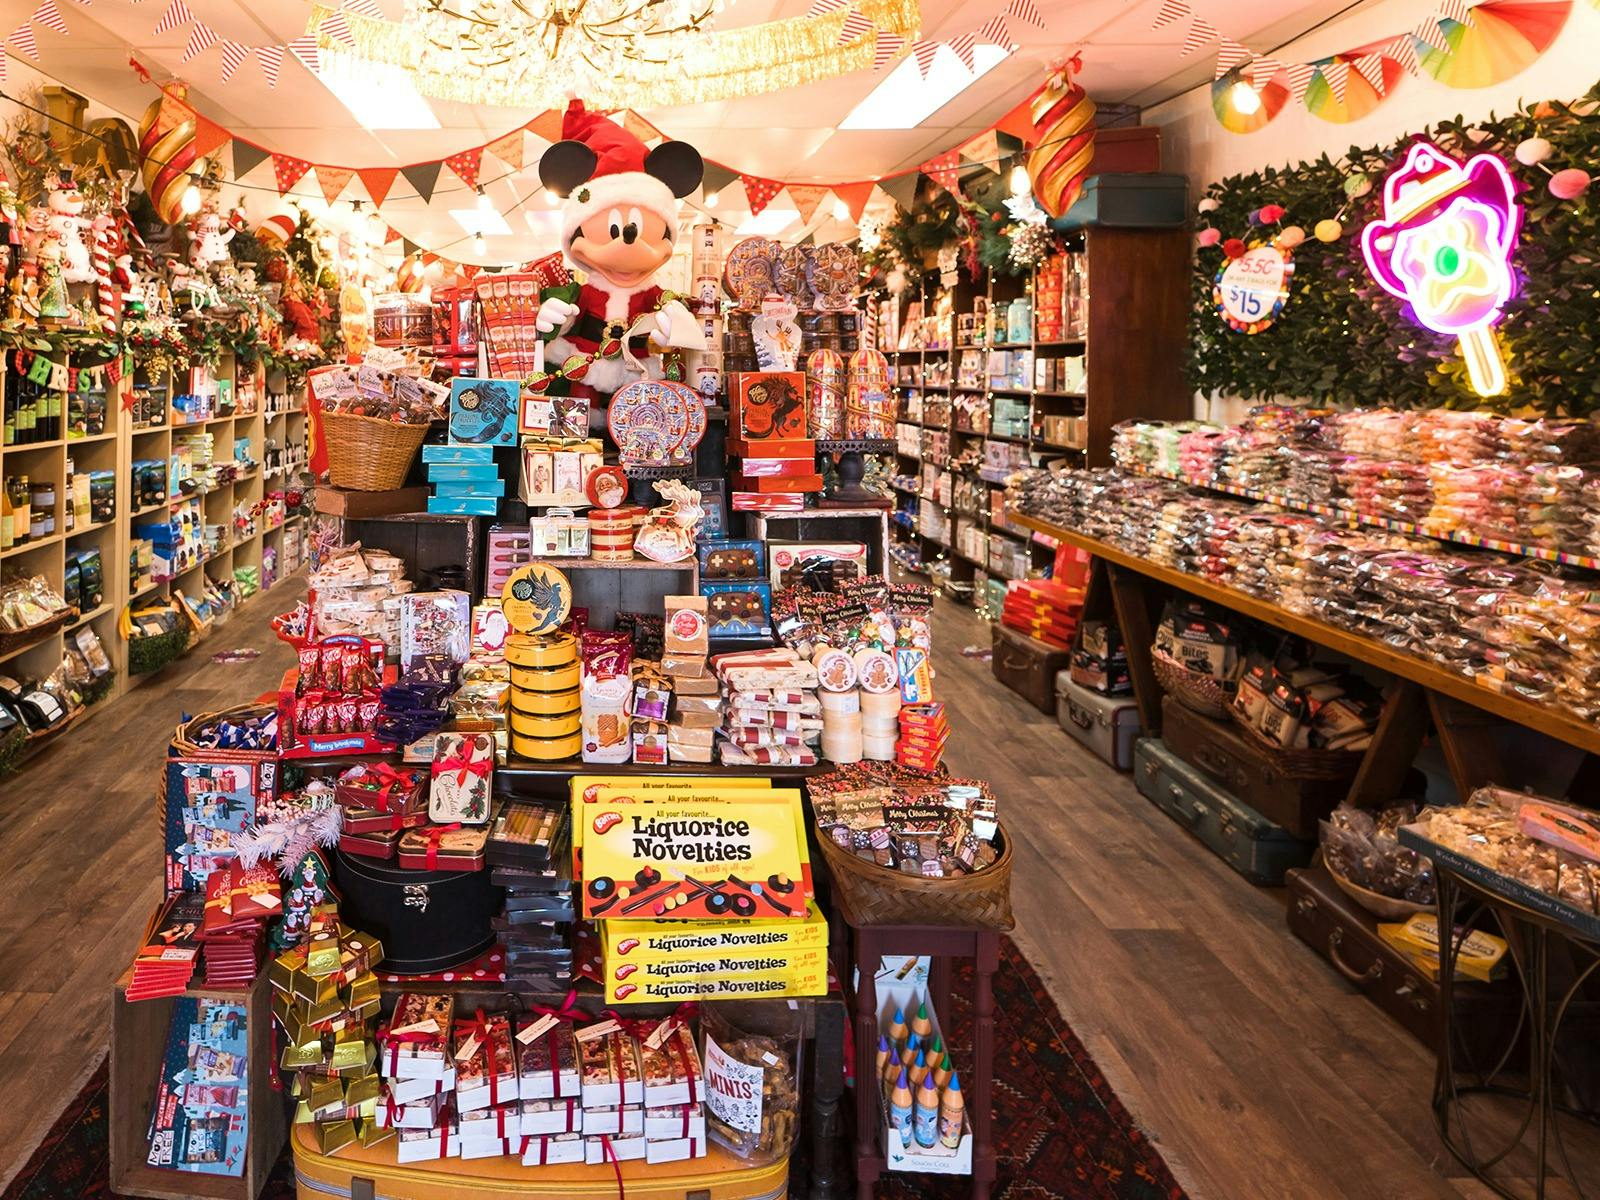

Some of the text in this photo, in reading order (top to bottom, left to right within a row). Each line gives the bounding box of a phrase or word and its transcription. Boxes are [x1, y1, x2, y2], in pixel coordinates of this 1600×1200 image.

[1230, 285, 1261, 315] $15
[315, 742, 334, 750] Merry
[632, 816, 749, 842] Liquorice
[633, 838, 752, 863] Novelties
[705, 865, 720, 873] KIDS
[648, 932, 788, 952] Liquorice Novelties
[647, 958, 787, 978] Liquorice Novelties
[646, 980, 786, 998] Liquorice Novelties
[709, 1069, 752, 1099] MINIS
